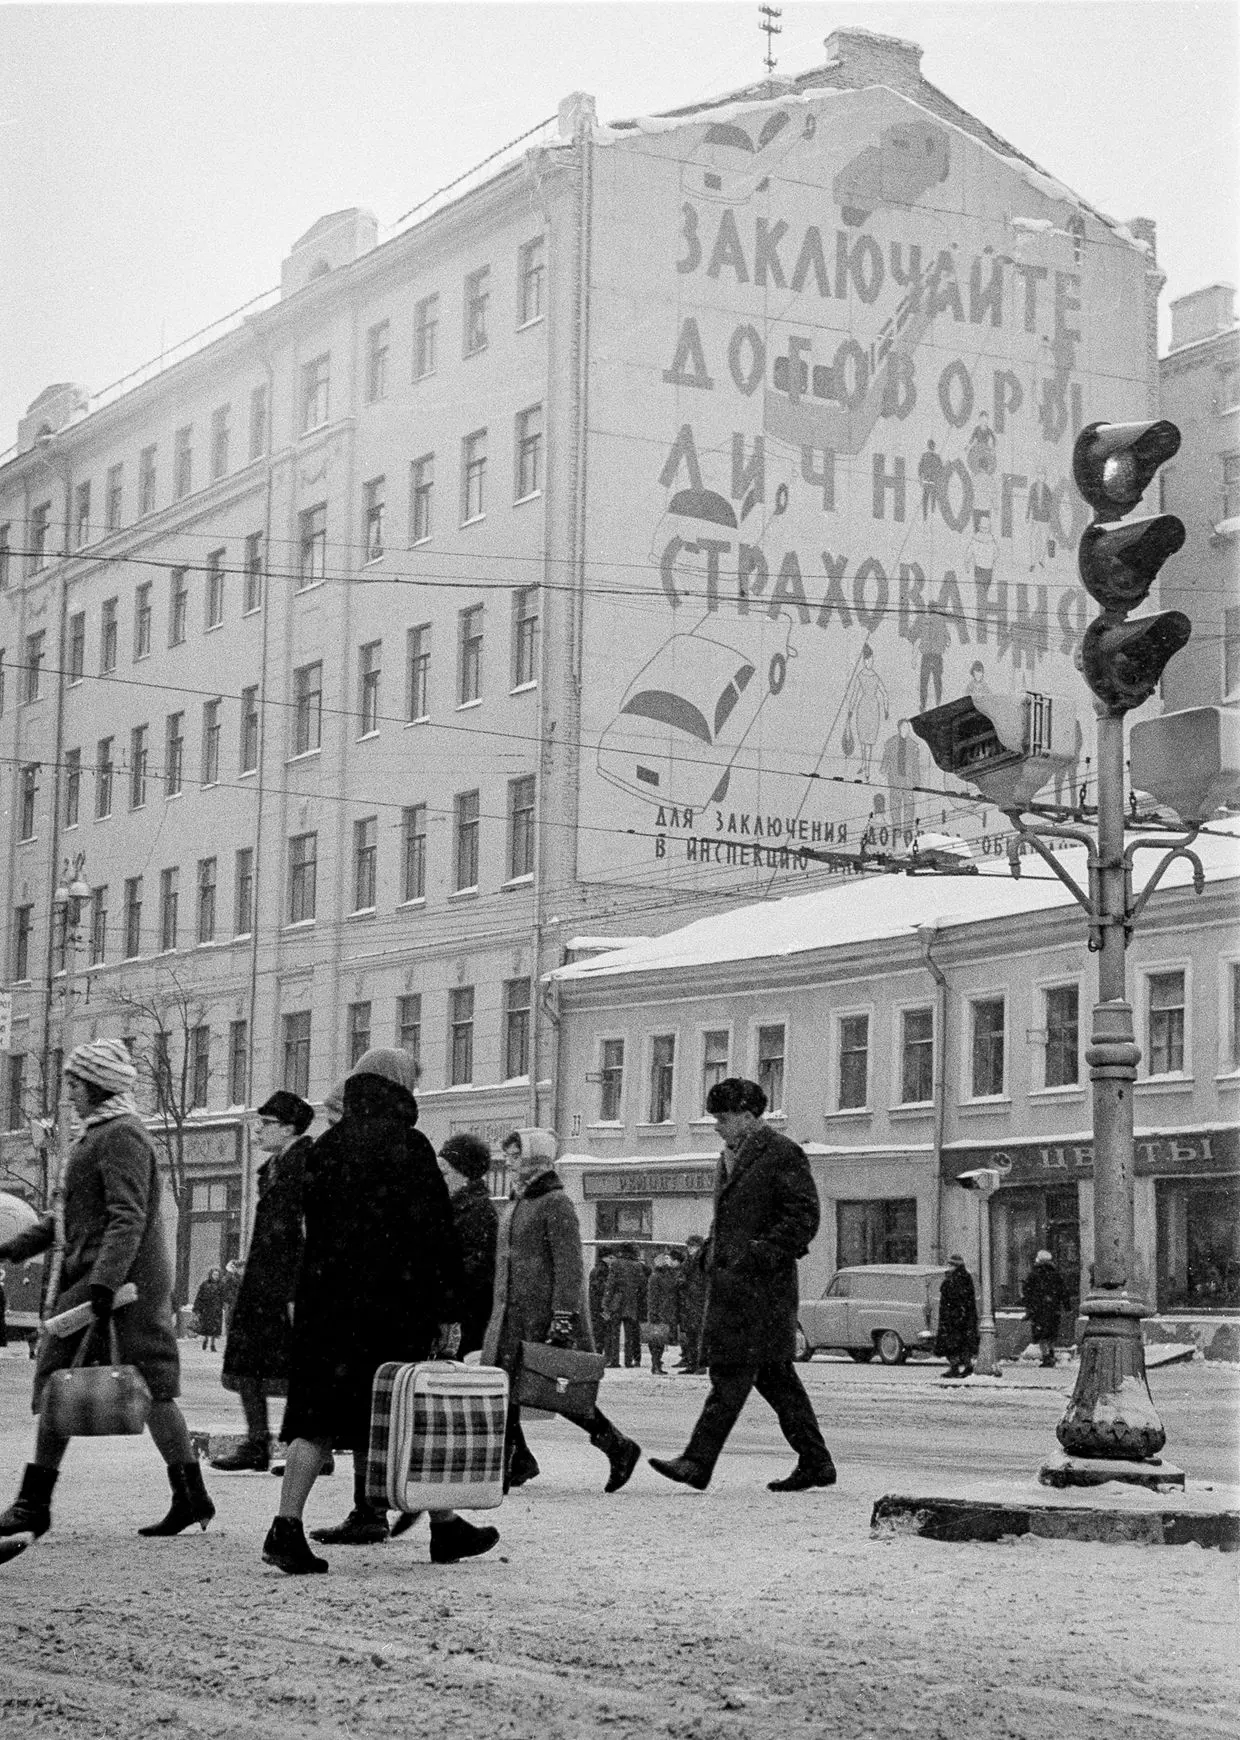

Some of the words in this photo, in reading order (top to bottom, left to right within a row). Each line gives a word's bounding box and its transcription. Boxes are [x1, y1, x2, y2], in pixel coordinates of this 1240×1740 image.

[675, 202, 1082, 339] ЗАКЛЮЧАЙТЕ
[662, 317, 1083, 443] ДОГОВОРЫ
[659, 424, 1092, 549] ЛИЧНОГО
[660, 535, 1088, 656] СТРАХОВАНИЯ
[655, 806, 694, 829] ДЛЯ
[716, 811, 847, 843] ЗАКЛЮЧЕНИЯ
[656, 838, 666, 858] В
[1039, 1139, 1214, 1170] ЦВТЫ
